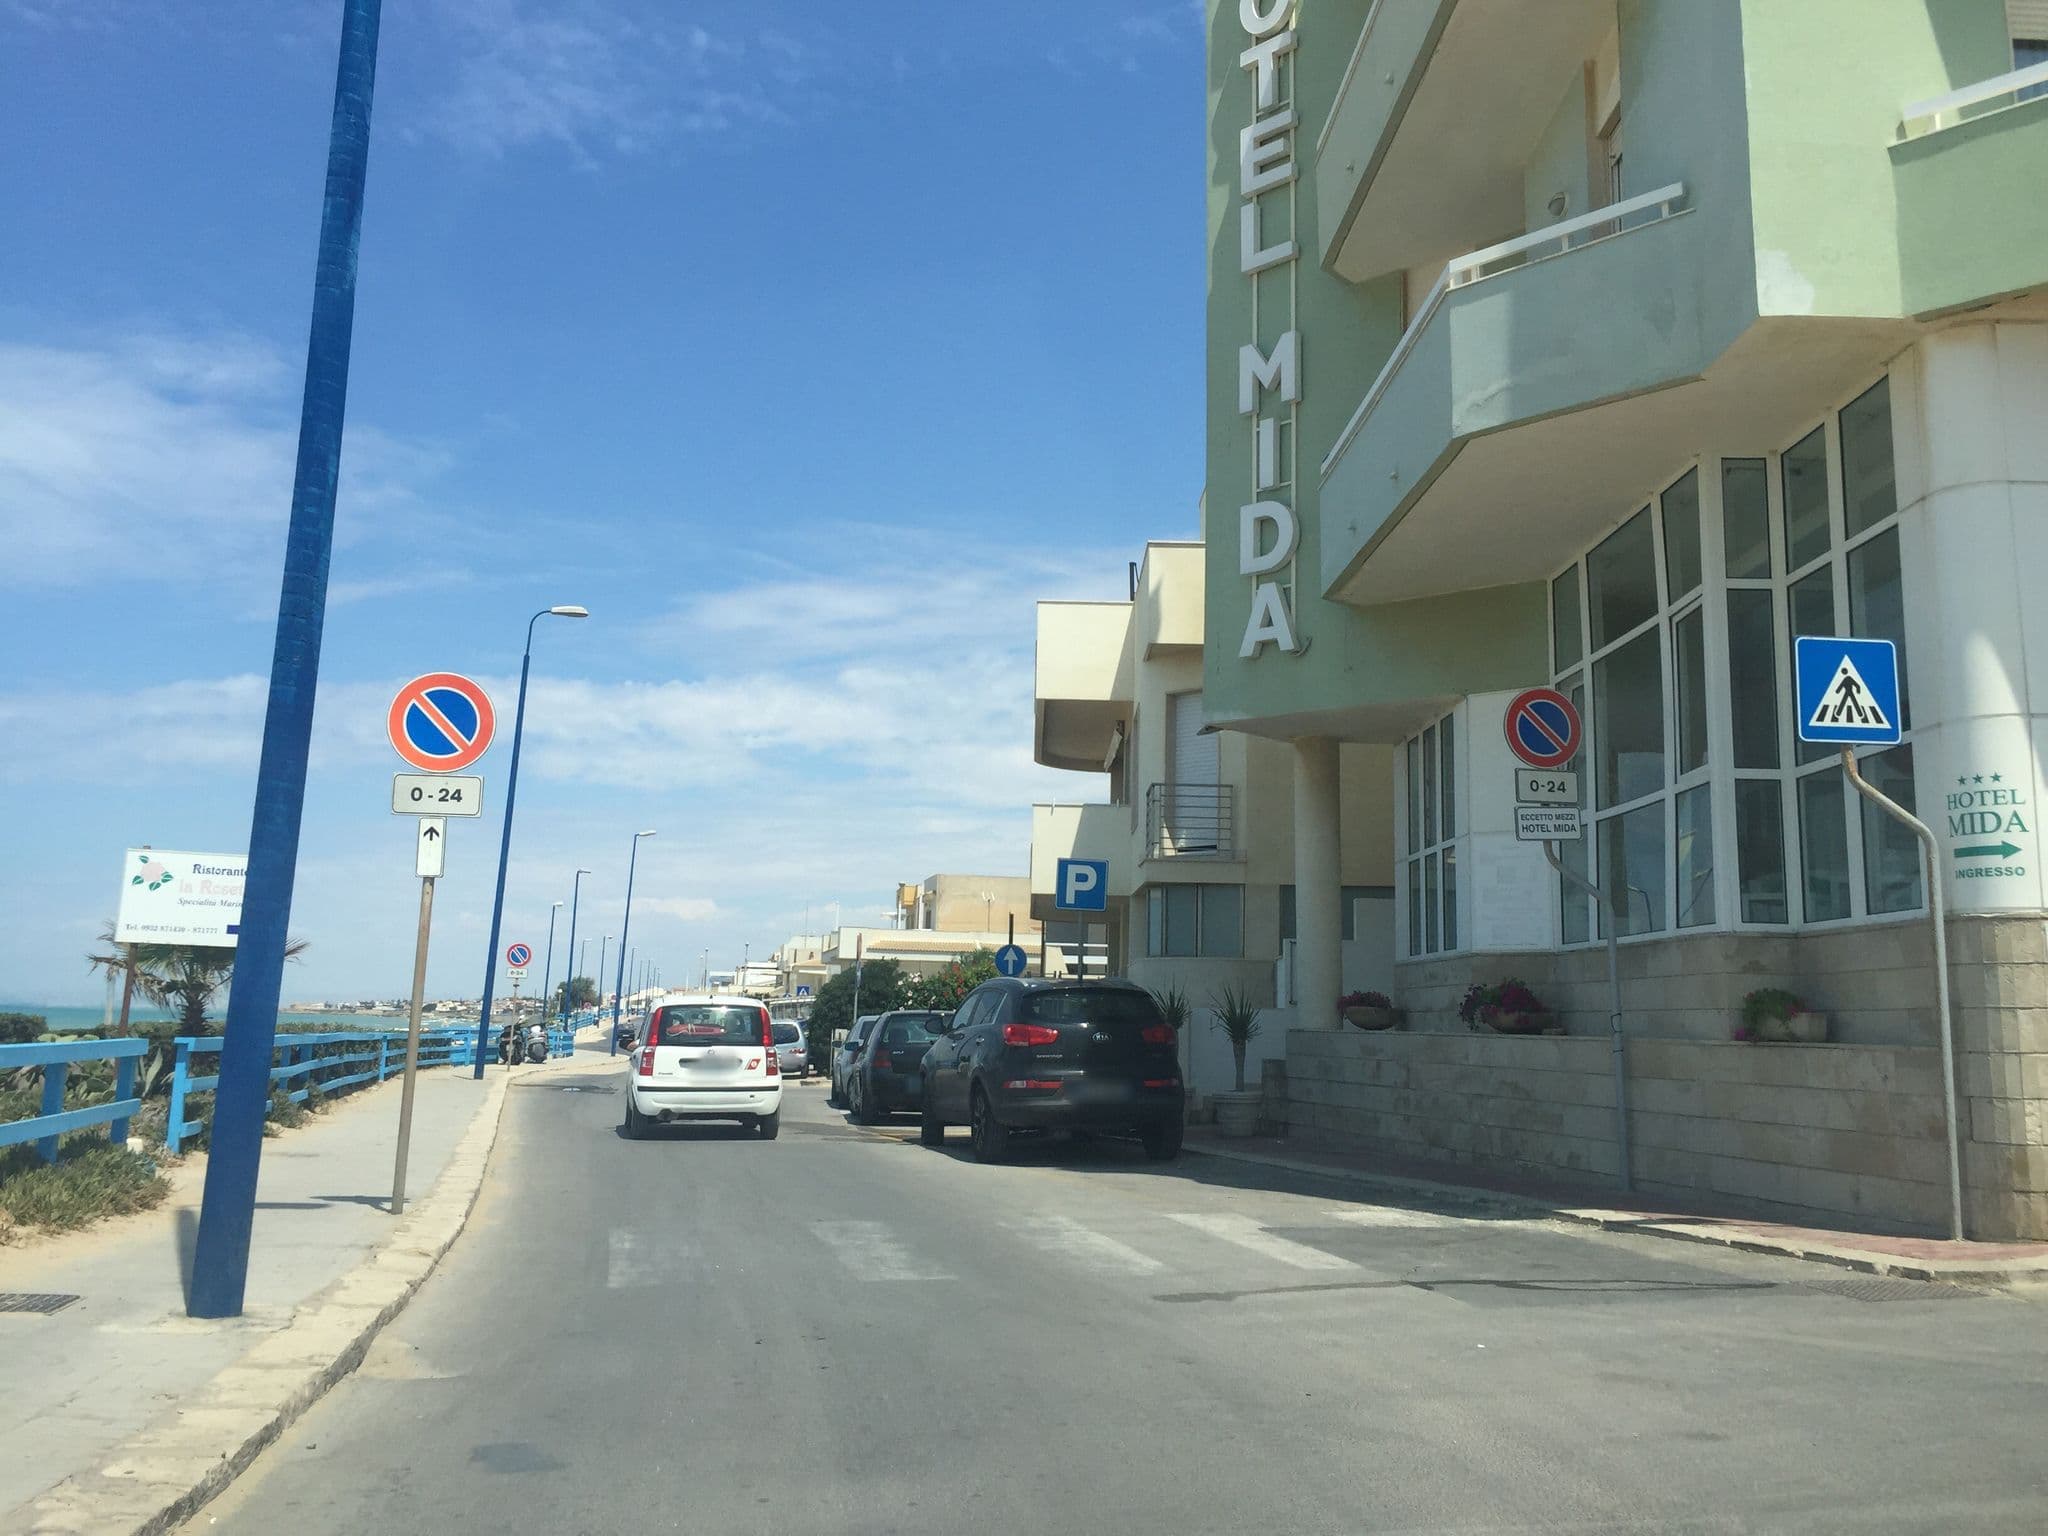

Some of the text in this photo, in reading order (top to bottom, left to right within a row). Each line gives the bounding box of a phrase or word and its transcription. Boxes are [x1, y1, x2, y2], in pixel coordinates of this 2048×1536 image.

[1239, 330, 1303, 659] MIDA
[1946, 789, 2026, 810] HOTEL
[1520, 813, 1553, 821] ECCETTO
[1947, 810, 2030, 838] MIDA
[1521, 824, 1577, 833] HOTEL MIDA
[1955, 866, 2025, 879] INGRESSO
[1066, 864, 1098, 904] P
